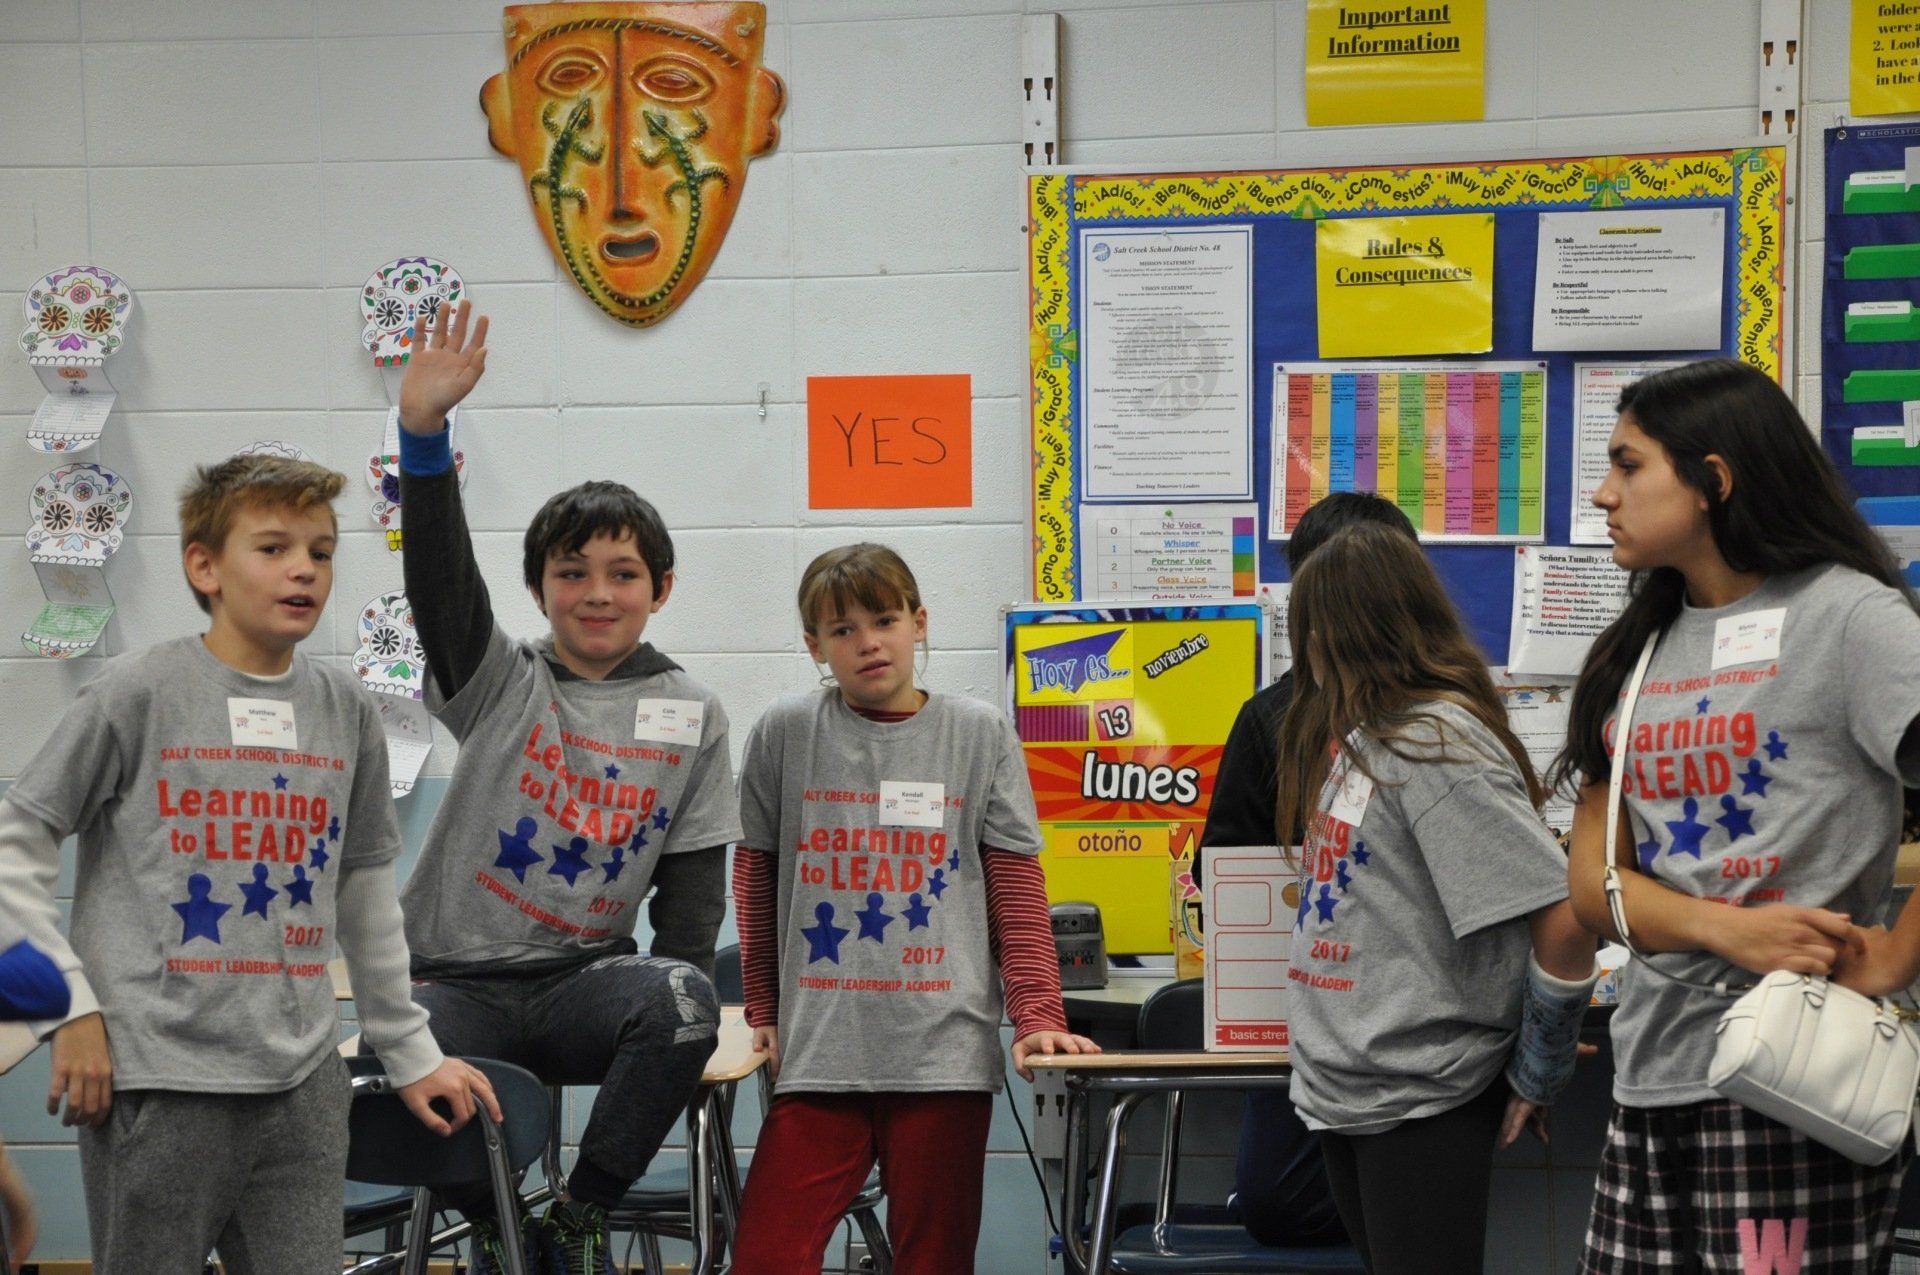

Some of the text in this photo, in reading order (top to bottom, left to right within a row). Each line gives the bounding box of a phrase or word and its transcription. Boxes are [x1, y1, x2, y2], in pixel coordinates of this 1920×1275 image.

[1339, 4, 1450, 30] Important
[1878, 24, 1913, 34] were
[1328, 32, 1460, 55] Information
[1873, 40, 1884, 51] 2.
[1876, 57, 1908, 68] have
[1876, 72, 1915, 85] in the
[1094, 184, 1145, 209] ¡Adiós!
[1152, 183, 1238, 210] ¡Bienvenidos!
[1246, 181, 1299, 207] ¡Buenos
[1301, 176, 1335, 203] días!
[1346, 174, 1391, 201] ¿Cómo
[1393, 173, 1434, 203] estás?
[1446, 171, 1480, 197] ¡Muy
[1482, 172, 1517, 204] bien!
[1522, 164, 1584, 199] ¡Gracias!
[1629, 164, 1668, 196] ¡Hola!
[1675, 161, 1732, 191] ¡Adiós!
[1128, 246, 1147, 254] Creek
[1367, 236, 1444, 259] Rules &
[1336, 266, 1473, 286] Consequences
[832, 412, 947, 468] YES
[1162, 521, 1202, 529] No Voice
[1164, 539, 1201, 548] Whisper
[1111, 563, 1118, 571] 2
[1188, 557, 1212, 565] Voice
[1538, 554, 1566, 562] Señora
[1111, 581, 1118, 590] 3
[1157, 576, 1207, 584] Class Voice
[1145, 633, 1210, 678] noviembre
[1028, 654, 1130, 693] Hoy es...
[1675, 675, 1713, 694] SCHOOL
[1714, 668, 1765, 687] DISTRICT
[1098, 706, 1131, 738] 13
[160, 747, 190, 761] SALT
[194, 747, 232, 762] CREEK
[235, 748, 280, 764] SCHOOL
[283, 752, 329, 770] DISTRICT
[575, 735, 614, 756] SCHOOL
[615, 747, 665, 764] DISTRICT
[1083, 751, 1198, 805] lunes
[1634, 749, 1732, 801] LEAD
[157, 778, 328, 836] Learning
[519, 771, 635, 847] to LEAD
[824, 791, 857, 804] CREEK
[170, 822, 306, 863] to LEAD
[1078, 830, 1142, 853] otoño
[800, 856, 924, 893] to LEAD
[1721, 855, 1782, 879] 2017
[475, 870, 519, 906] STUDENT
[285, 924, 324, 948] 2017
[902, 947, 945, 965] 2017
[1310, 939, 1352, 963] 2017
[167, 959, 222, 974] STUDENT
[799, 976, 951, 992] STUDENT LEADERSHIP ACADEMY
[1230, 1027, 1259, 1041] basic
[1737, 1217, 1809, 1275] W
